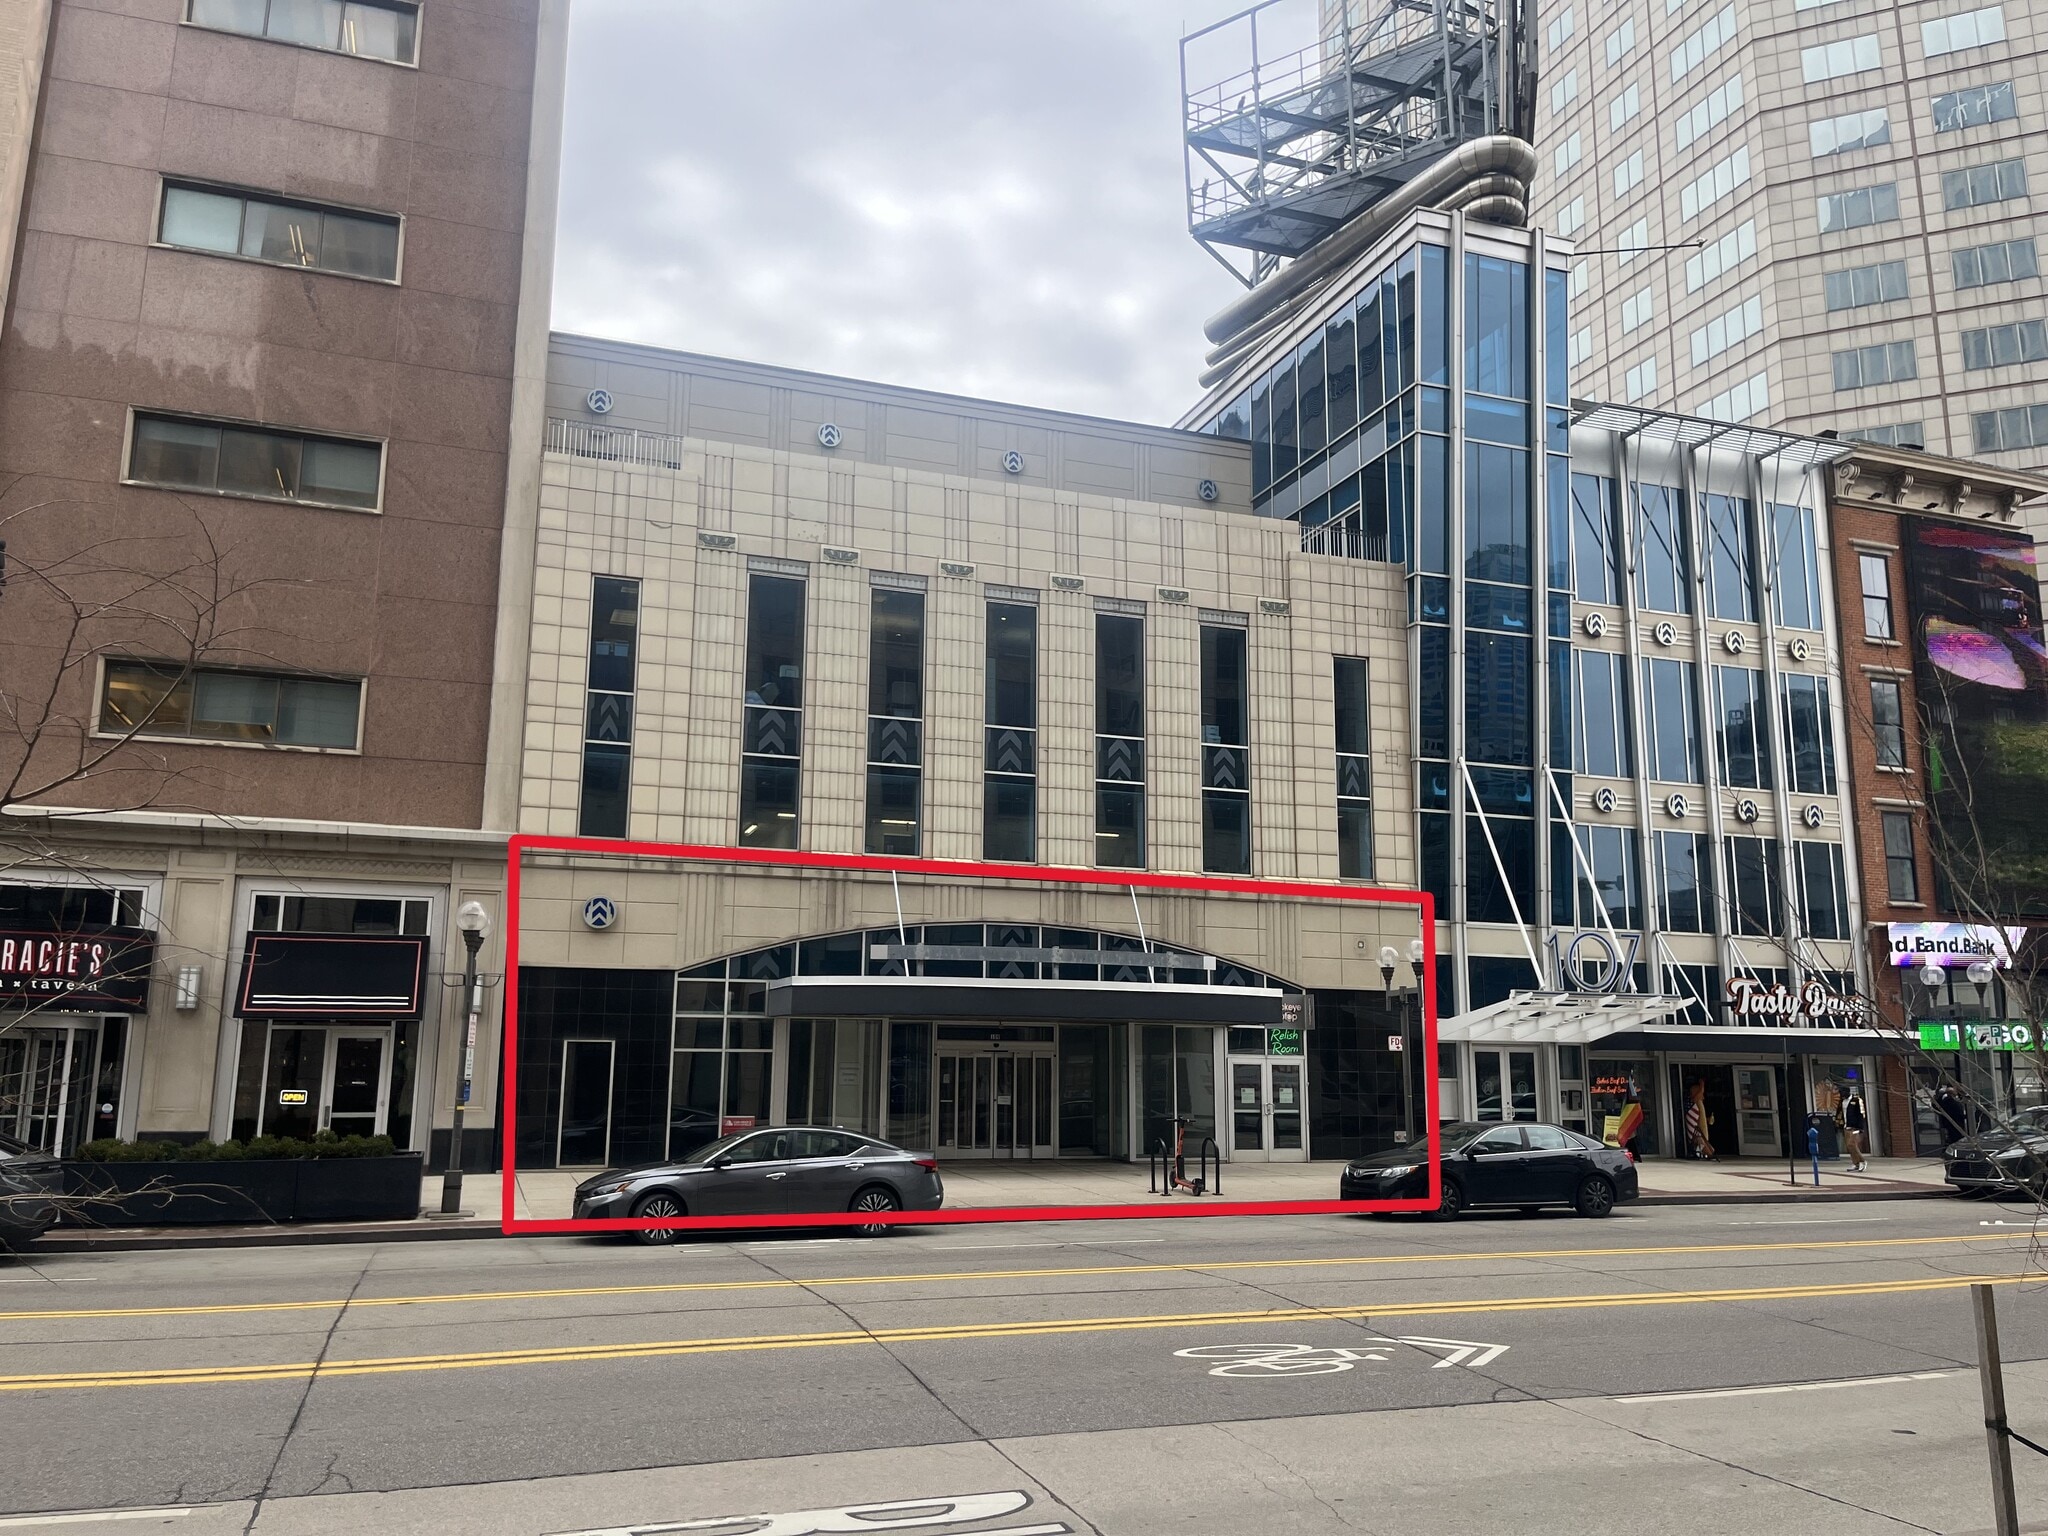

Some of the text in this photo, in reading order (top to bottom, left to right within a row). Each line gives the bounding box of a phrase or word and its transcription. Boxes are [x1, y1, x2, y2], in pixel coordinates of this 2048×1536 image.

[1545, 930, 1640, 992] 107
[1726, 977, 1800, 1024] Tasty
[1271, 1028, 1299, 1042] Relish
[1272, 1042, 1299, 1055] Room
[283, 1093, 305, 1102] OPEN
